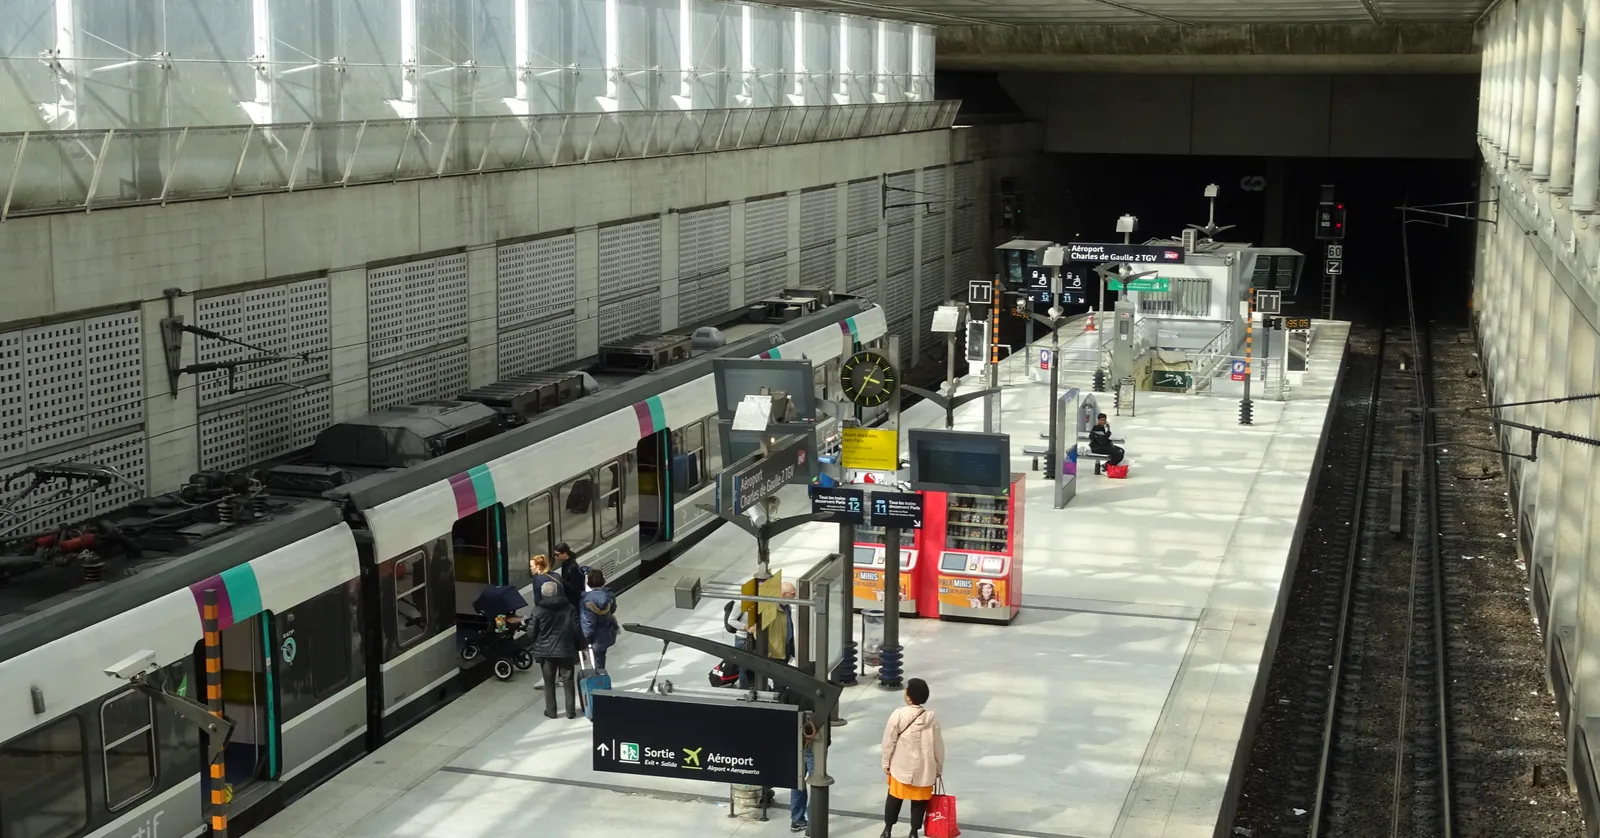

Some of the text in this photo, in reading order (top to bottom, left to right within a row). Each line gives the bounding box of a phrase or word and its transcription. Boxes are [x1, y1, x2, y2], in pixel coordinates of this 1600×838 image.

[1071, 245, 1104, 254] Aéroport
[1328, 246, 1342, 257] 60
[1329, 262, 1340, 273] Z
[740, 468, 763, 492] Aéroport
[741, 490, 760, 508] Charles
[760, 484, 766, 496] de
[767, 474, 781, 492] Gaulle
[785, 464, 794, 480] TGV
[848, 502, 860, 511] 12
[875, 504, 887, 513] 11
[860, 572, 878, 581] MINIS
[954, 580, 972, 588] MINIS
[644, 747, 675, 759] Sortie
[707, 752, 753, 766] Aéroport
